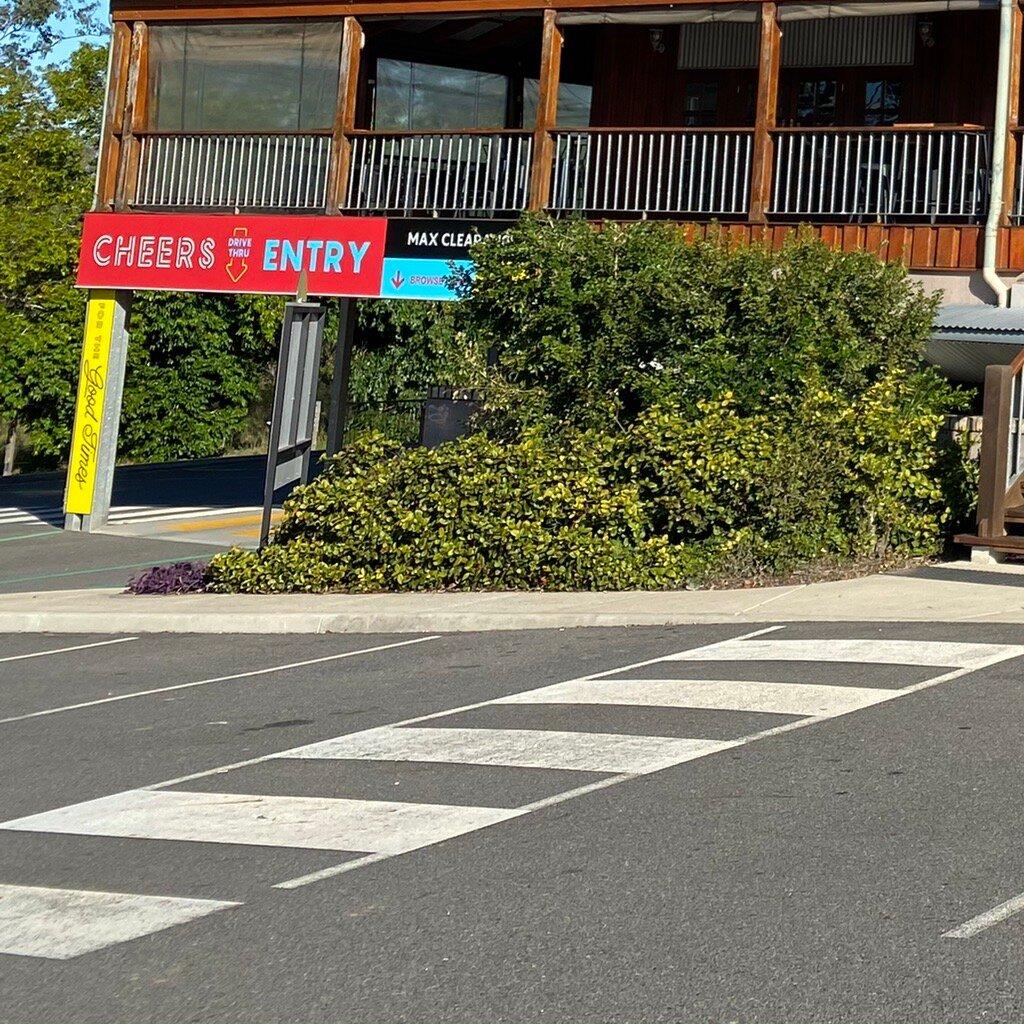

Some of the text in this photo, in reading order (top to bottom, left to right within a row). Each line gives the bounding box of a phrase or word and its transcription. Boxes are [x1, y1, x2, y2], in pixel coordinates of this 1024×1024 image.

[227, 237, 252, 248] DRIVE
[407, 231, 439, 246] MAX
[93, 234, 371, 274] CHEERS ENTRY
[228, 248, 250, 258] THRU
[75, 359, 103, 490] Good Times
